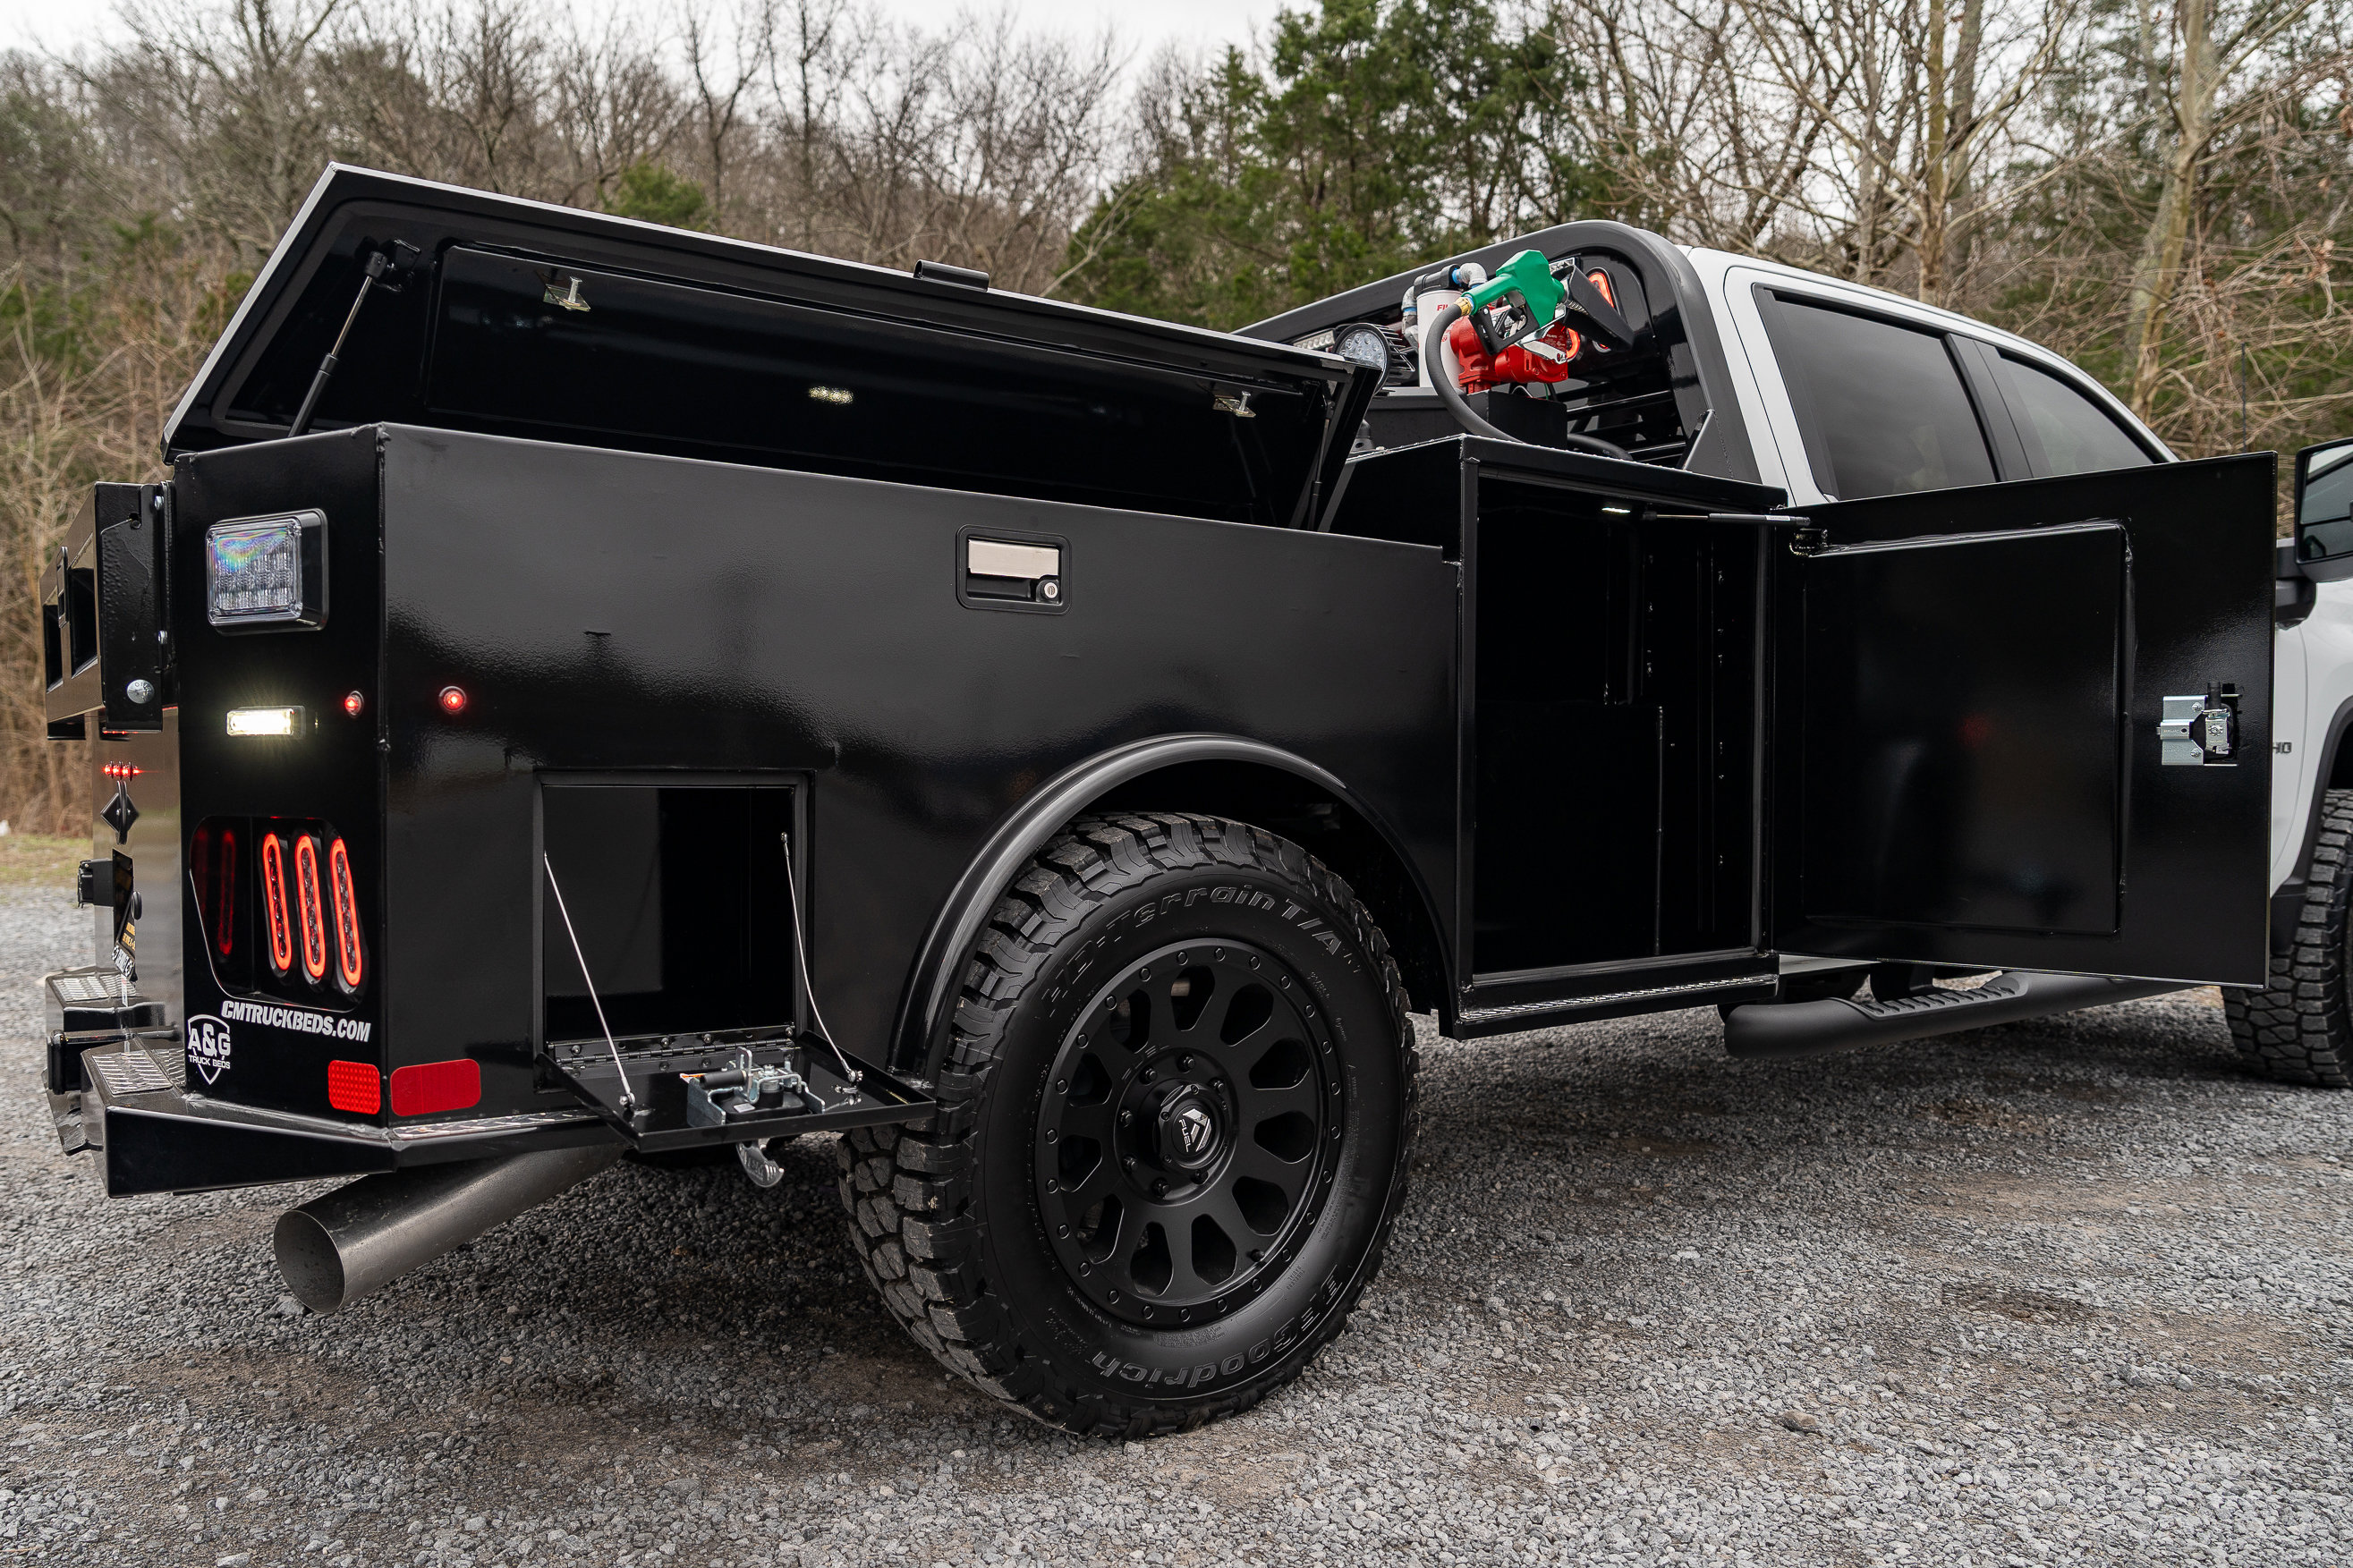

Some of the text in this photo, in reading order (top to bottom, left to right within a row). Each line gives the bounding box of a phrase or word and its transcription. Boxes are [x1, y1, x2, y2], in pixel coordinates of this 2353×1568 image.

[1281, 897, 1346, 956] T/A
[221, 1000, 371, 1042] CMTRUCKBEDS.COM
[187, 1023, 231, 1057] A&G
[189, 1054, 231, 1069] TRUCK BEDS
[1178, 1118, 1192, 1153] FUEL
